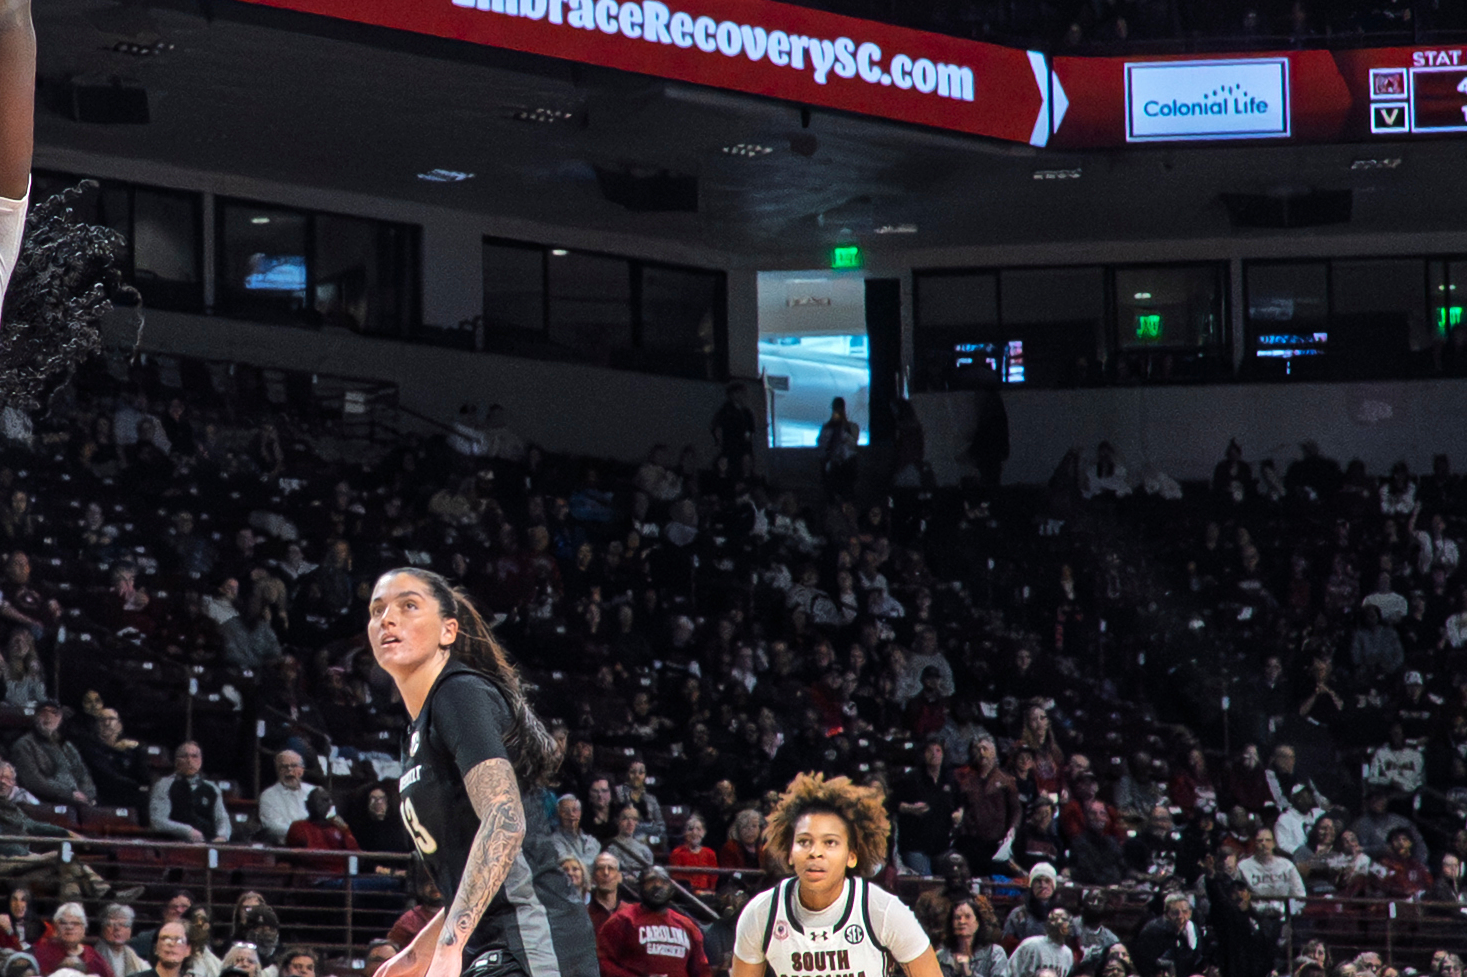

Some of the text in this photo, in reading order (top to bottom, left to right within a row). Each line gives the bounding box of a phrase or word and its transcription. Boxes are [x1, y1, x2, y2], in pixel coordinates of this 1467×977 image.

[1413, 50, 1462, 66] STAT
[1144, 97, 1268, 117] Colonial Life
[639, 925, 691, 950] CAROLINA
[791, 949, 851, 972] SOUTH
